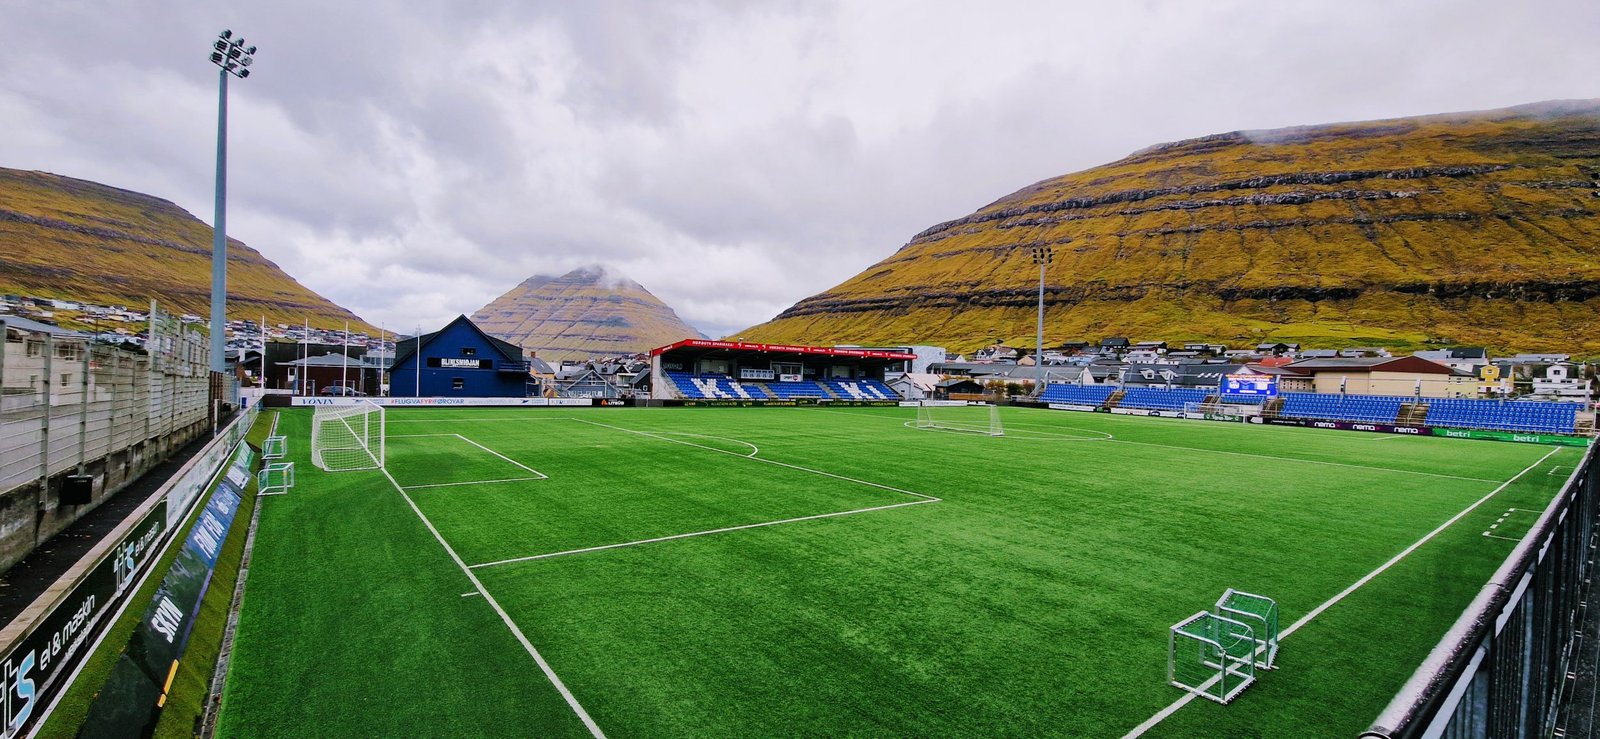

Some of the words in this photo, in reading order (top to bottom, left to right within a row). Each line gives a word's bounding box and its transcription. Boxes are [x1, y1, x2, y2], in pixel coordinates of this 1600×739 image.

[1446, 430, 1470, 438] betri
[1513, 434, 1540, 443] betri
[40, 641, 51, 671] el
[52, 631, 61, 657] &
[62, 594, 95, 645] maskin
[151, 595, 184, 643] SKYN
